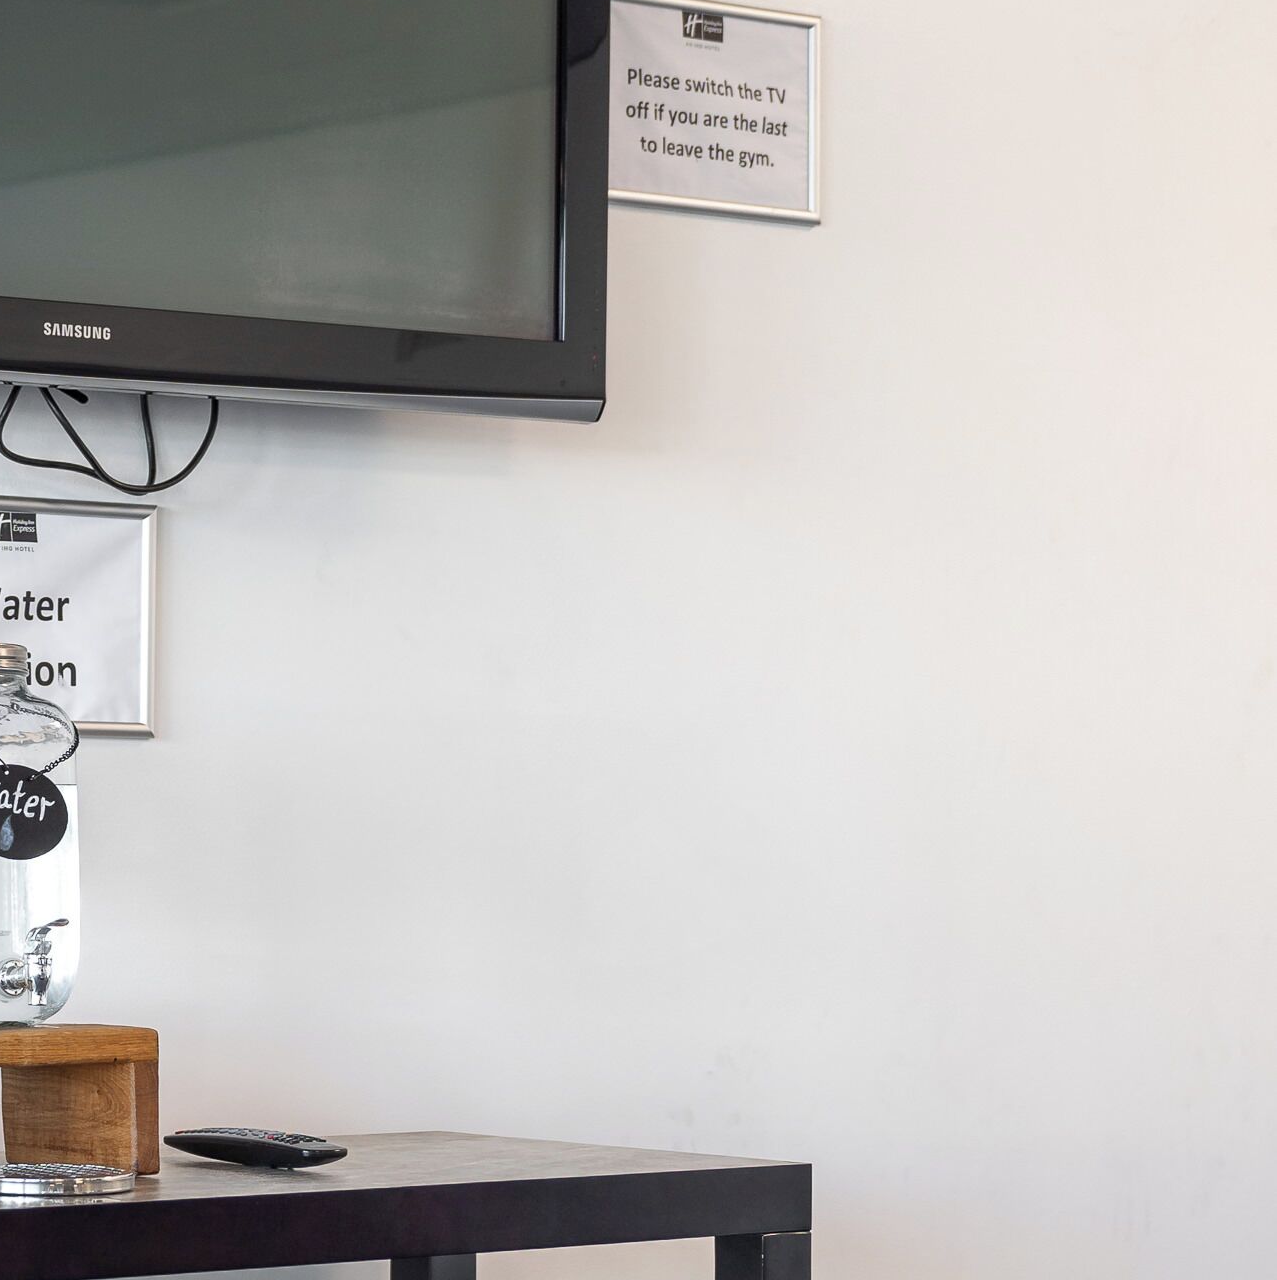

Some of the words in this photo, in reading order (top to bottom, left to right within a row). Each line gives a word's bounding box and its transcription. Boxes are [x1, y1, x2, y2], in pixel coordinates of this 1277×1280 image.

[627, 68, 680, 90] Please
[685, 77, 733, 97] switch
[738, 82, 762, 102] the
[766, 86, 786, 105] TV
[626, 101, 649, 120] off
[654, 103, 665, 121] if
[668, 109, 698, 127] you
[703, 113, 728, 129] are
[733, 113, 758, 133] the
[762, 116, 788, 137] last
[640, 136, 657, 153] to
[662, 137, 703, 159] leave
[708, 142, 734, 162] the
[739, 150, 774, 168] gym.
[43, 322, 111, 340] SAMSUNG
[12, 524, 35, 534] Express
